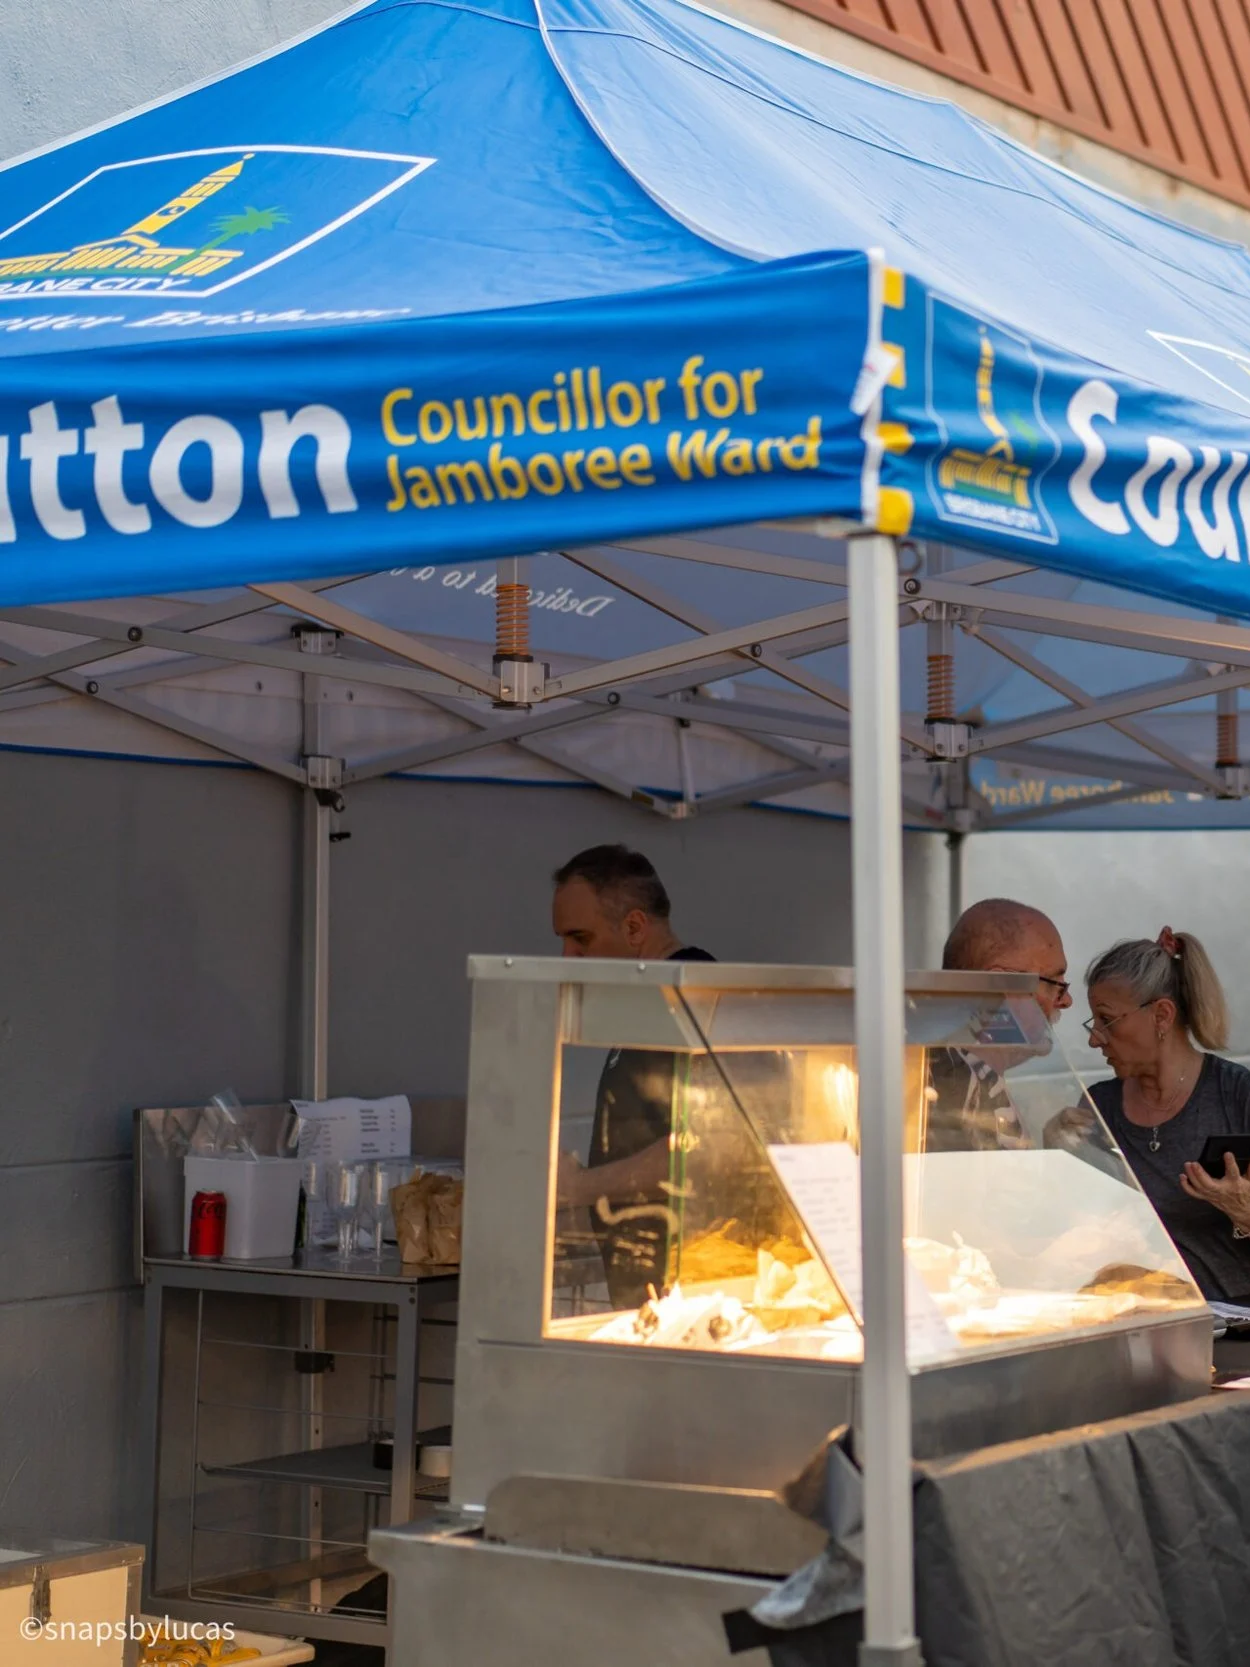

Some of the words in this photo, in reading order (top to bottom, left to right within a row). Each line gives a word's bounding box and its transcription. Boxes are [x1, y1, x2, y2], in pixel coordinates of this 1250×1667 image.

[90, 277, 191, 291] CITY
[381, 366, 666, 447] Councillor
[677, 355, 764, 421] for
[386, 442, 656, 512] Jamboree
[667, 416, 822, 481] Ward
